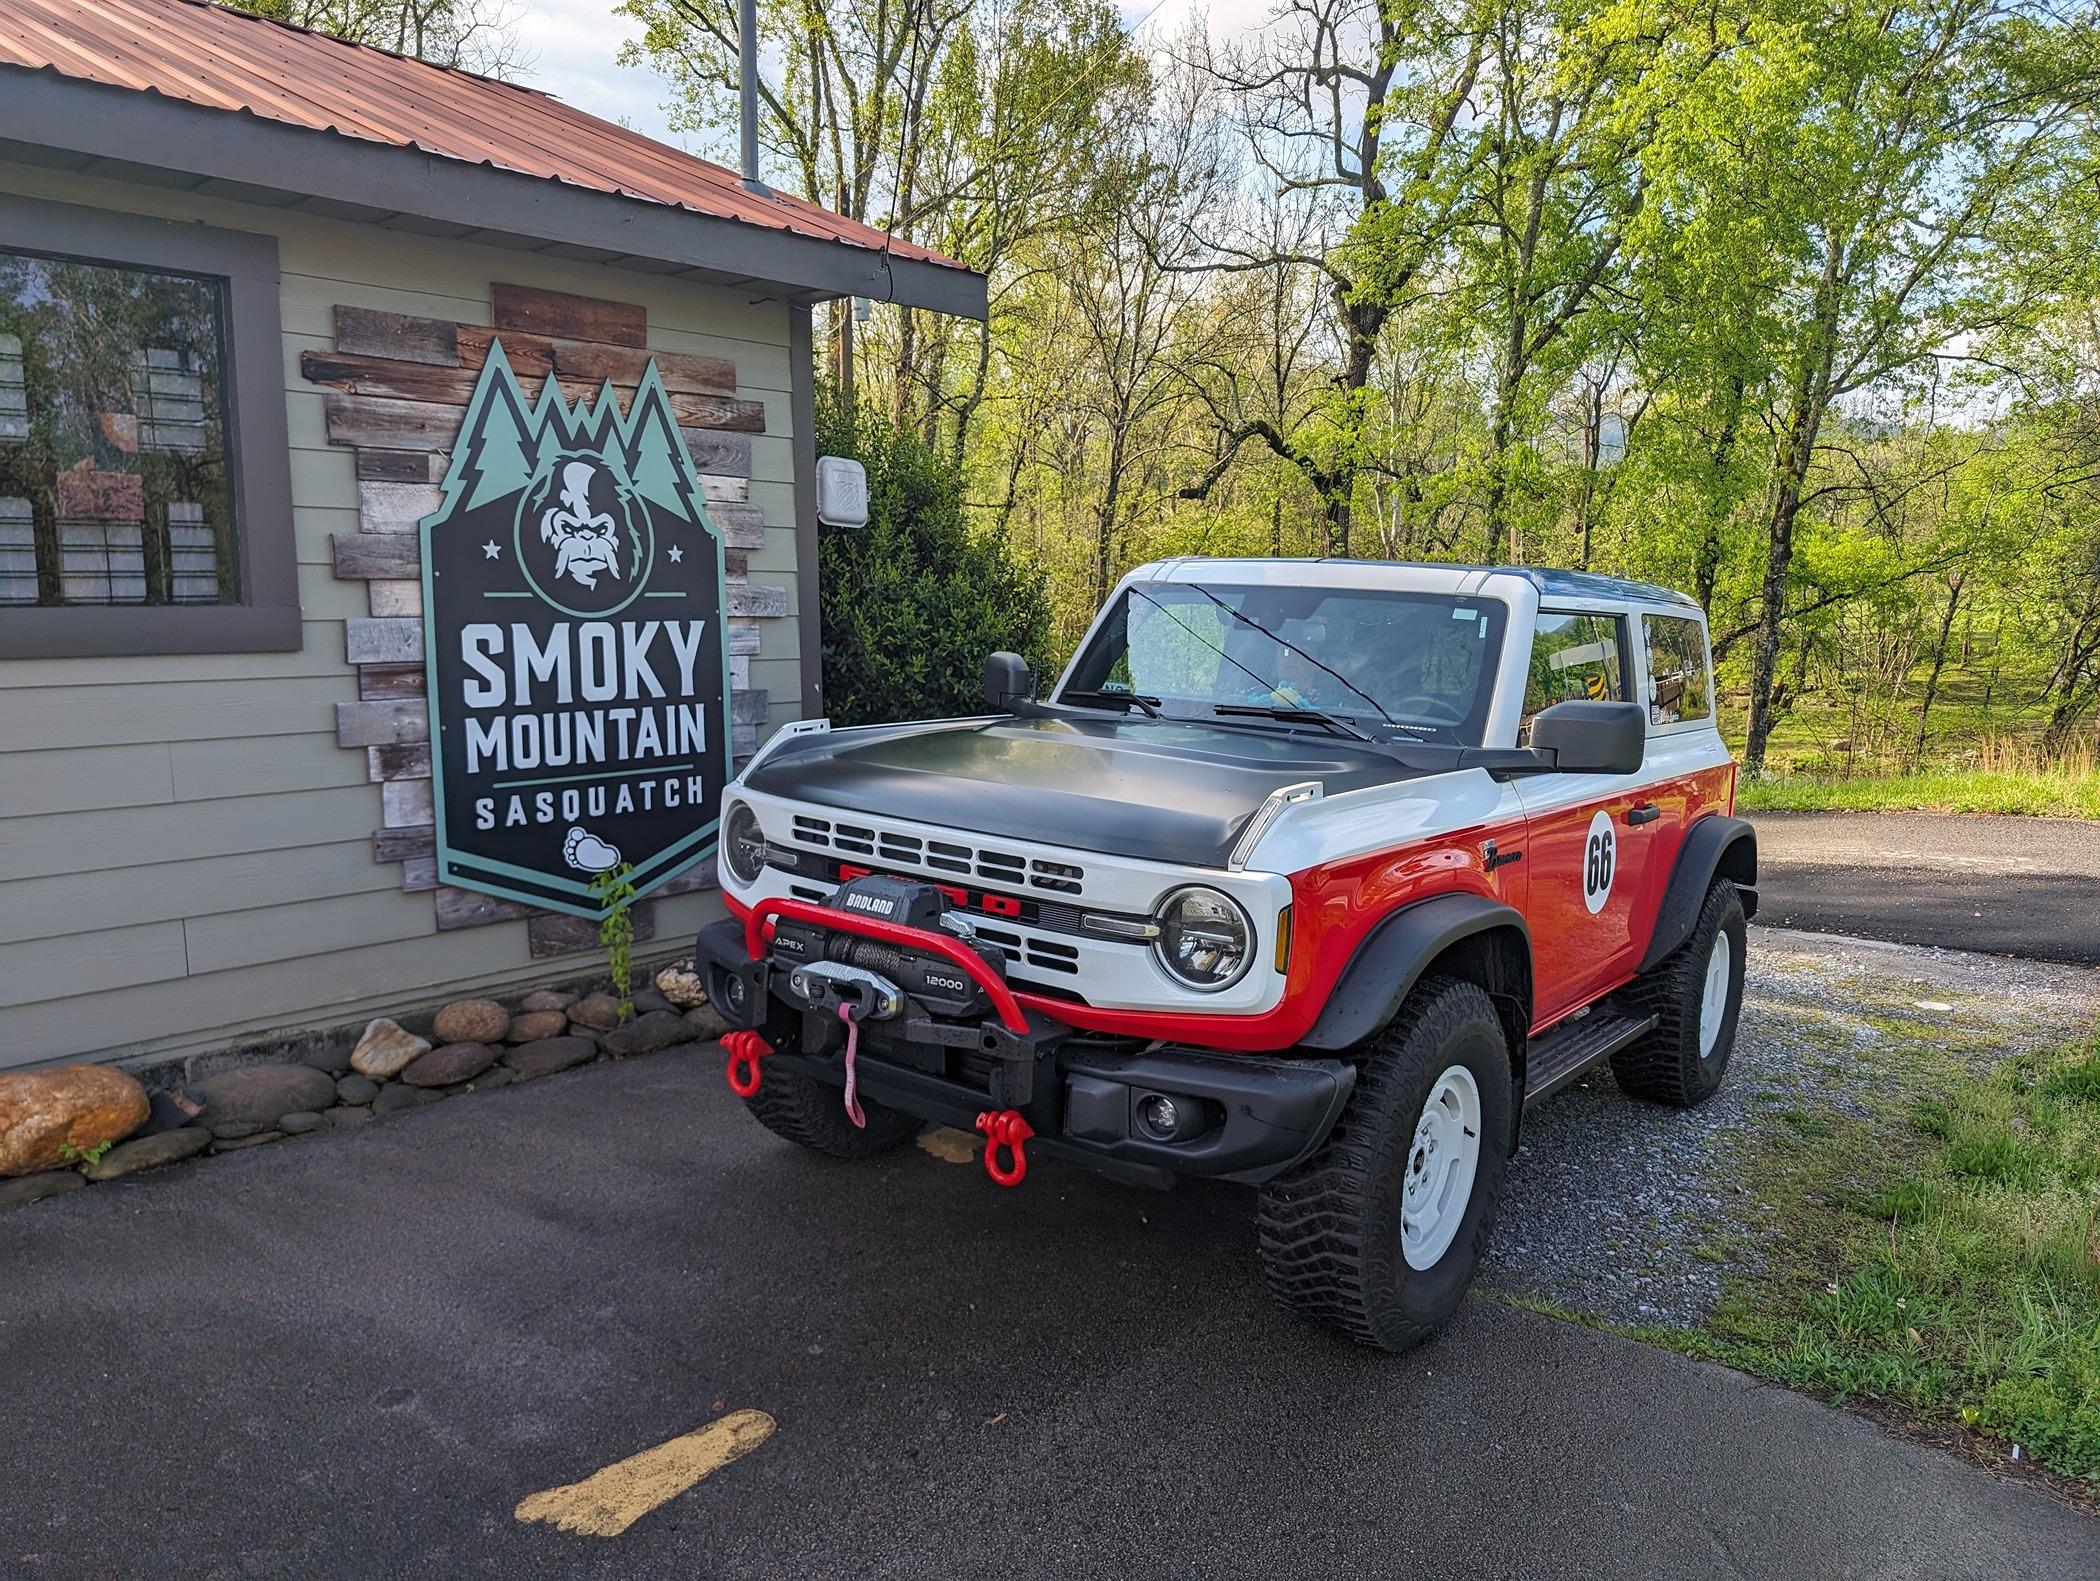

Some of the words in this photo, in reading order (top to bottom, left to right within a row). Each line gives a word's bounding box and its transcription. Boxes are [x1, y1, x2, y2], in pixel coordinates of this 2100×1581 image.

[461, 620, 706, 709] SMOKY
[464, 703, 706, 774] MOUNTAIN
[475, 775, 704, 831] SASQUATCH
[1587, 830, 1613, 897] 66
[845, 892, 895, 916] BADLAND
[774, 936, 805, 952] APEX
[925, 975, 964, 991] 12000
